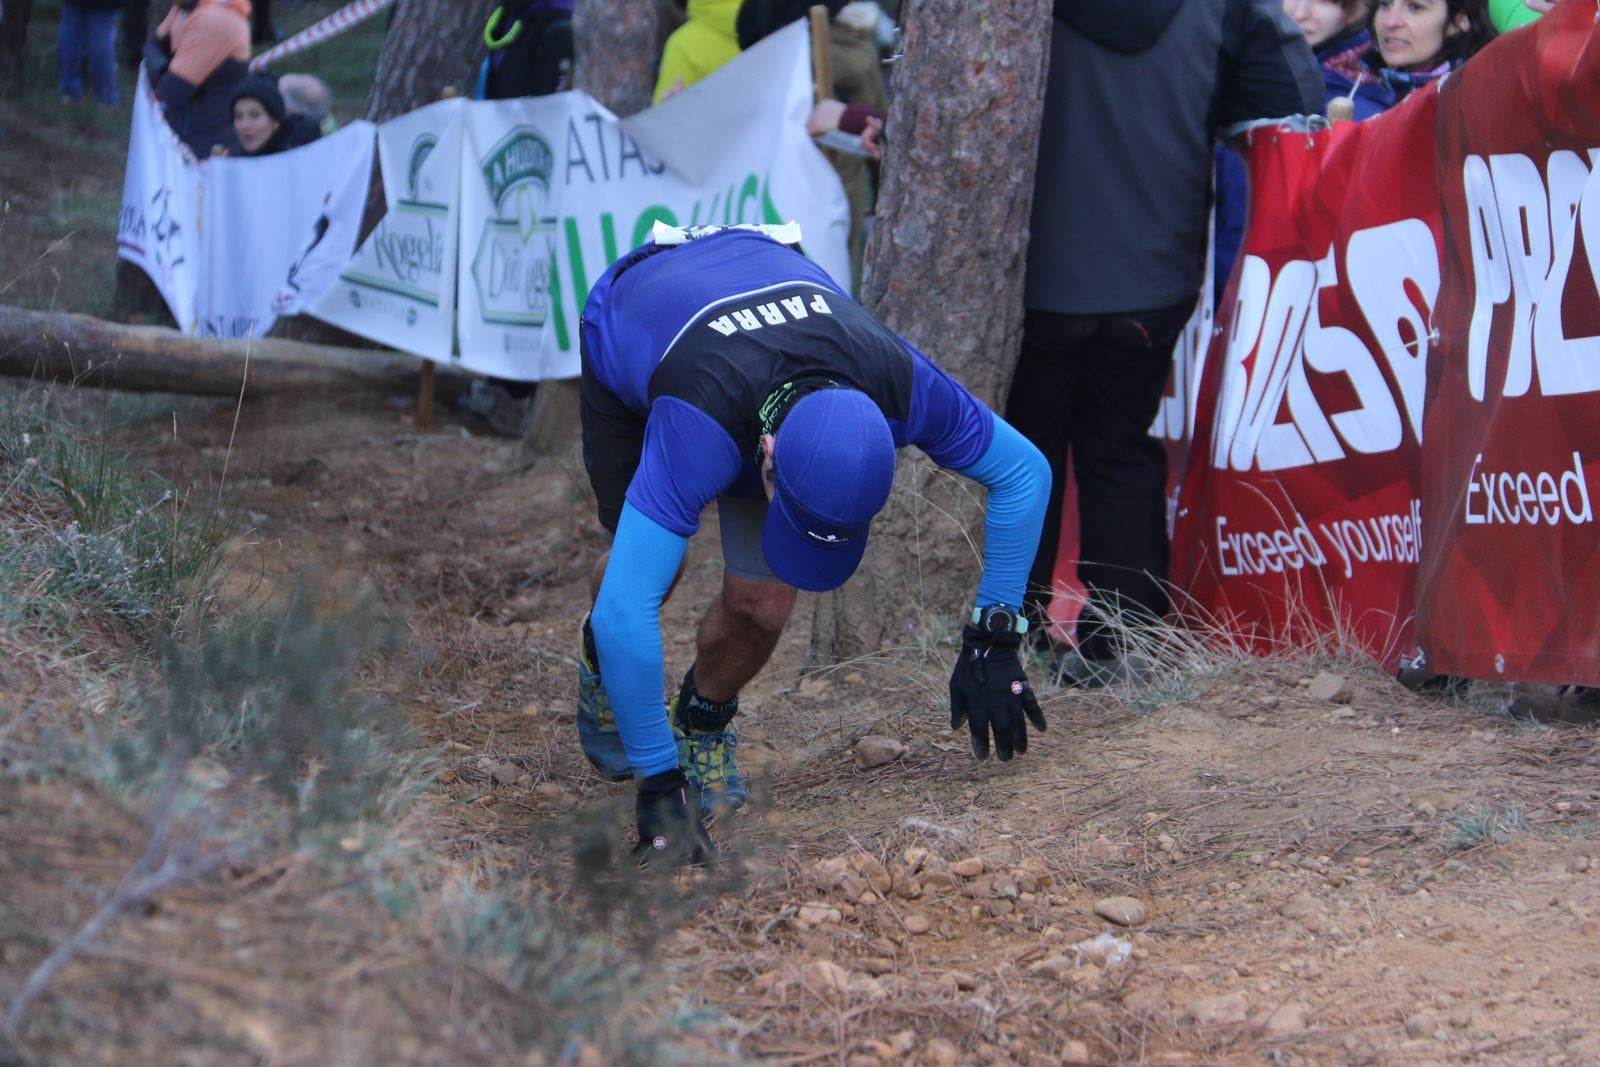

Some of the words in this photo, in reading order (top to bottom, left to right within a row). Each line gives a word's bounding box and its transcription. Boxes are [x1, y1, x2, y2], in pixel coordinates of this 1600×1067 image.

[707, 294, 833, 337] PARRA
[1465, 451, 1594, 526] Exceed
[1216, 512, 1328, 576] Exceed
[1319, 498, 1423, 579] yourself
